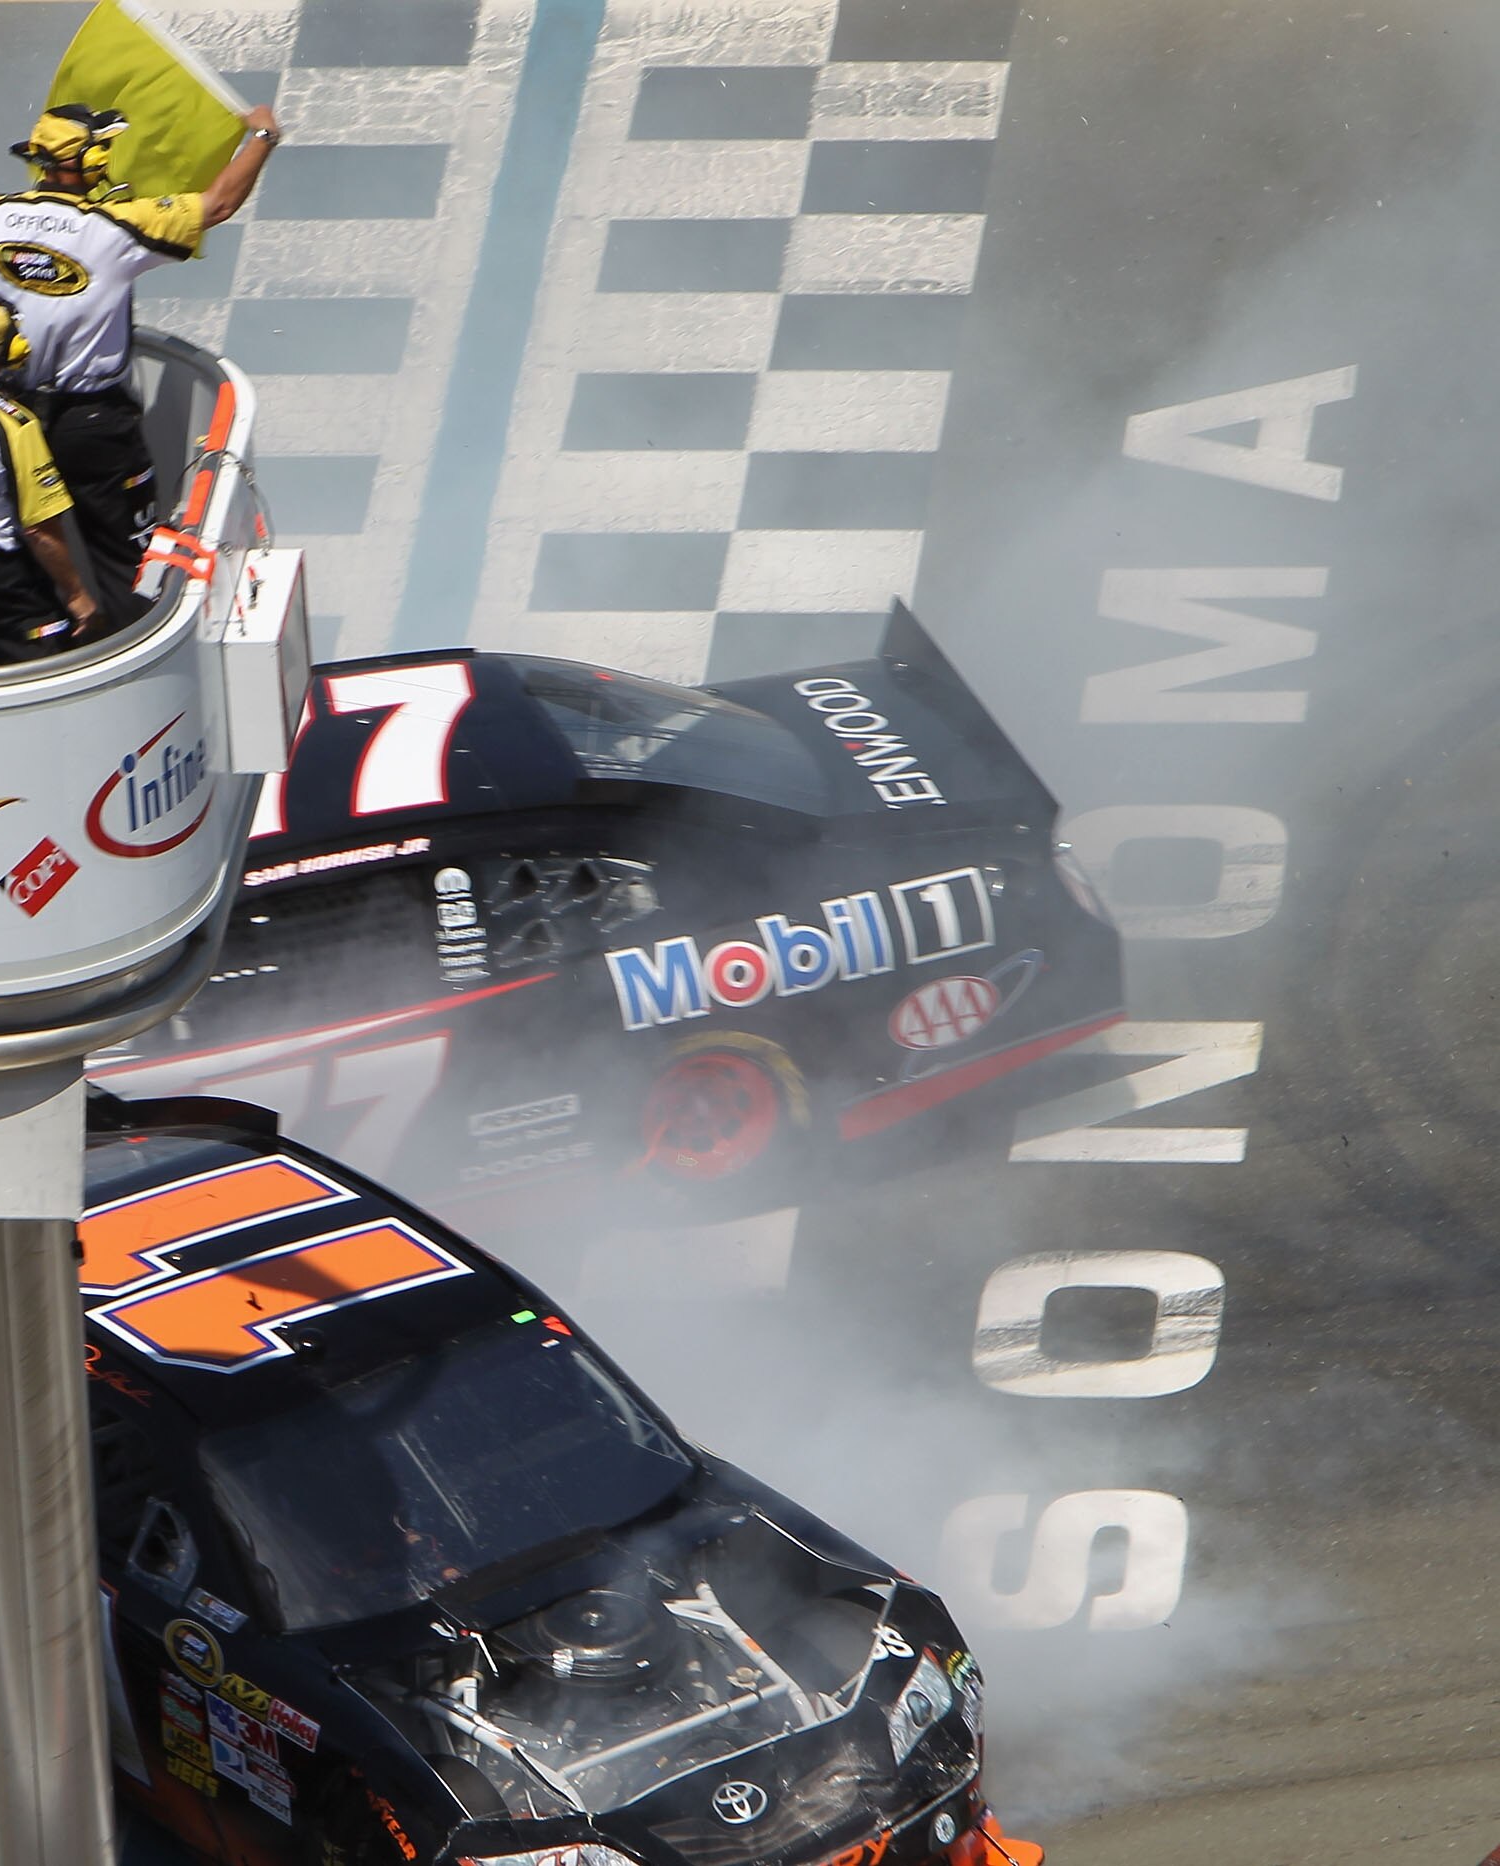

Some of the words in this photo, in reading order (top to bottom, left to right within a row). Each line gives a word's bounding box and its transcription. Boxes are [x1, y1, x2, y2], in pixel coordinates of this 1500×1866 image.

[4, 212, 80, 234] OFFICIAL
[245, 660, 473, 840] 7
[793, 677, 948, 809] ENWOOD
[604, 890, 896, 1032] Mobil
[919, 883, 962, 949] 1
[936, 363, 1358, 1631] SONOMA
[900, 976, 995, 1048] AAA
[80, 1155, 475, 1373] 11
[238, 1713, 278, 1762] 3M
[270, 1699, 318, 1748] Holley
[166, 1755, 219, 1798] JEGS
